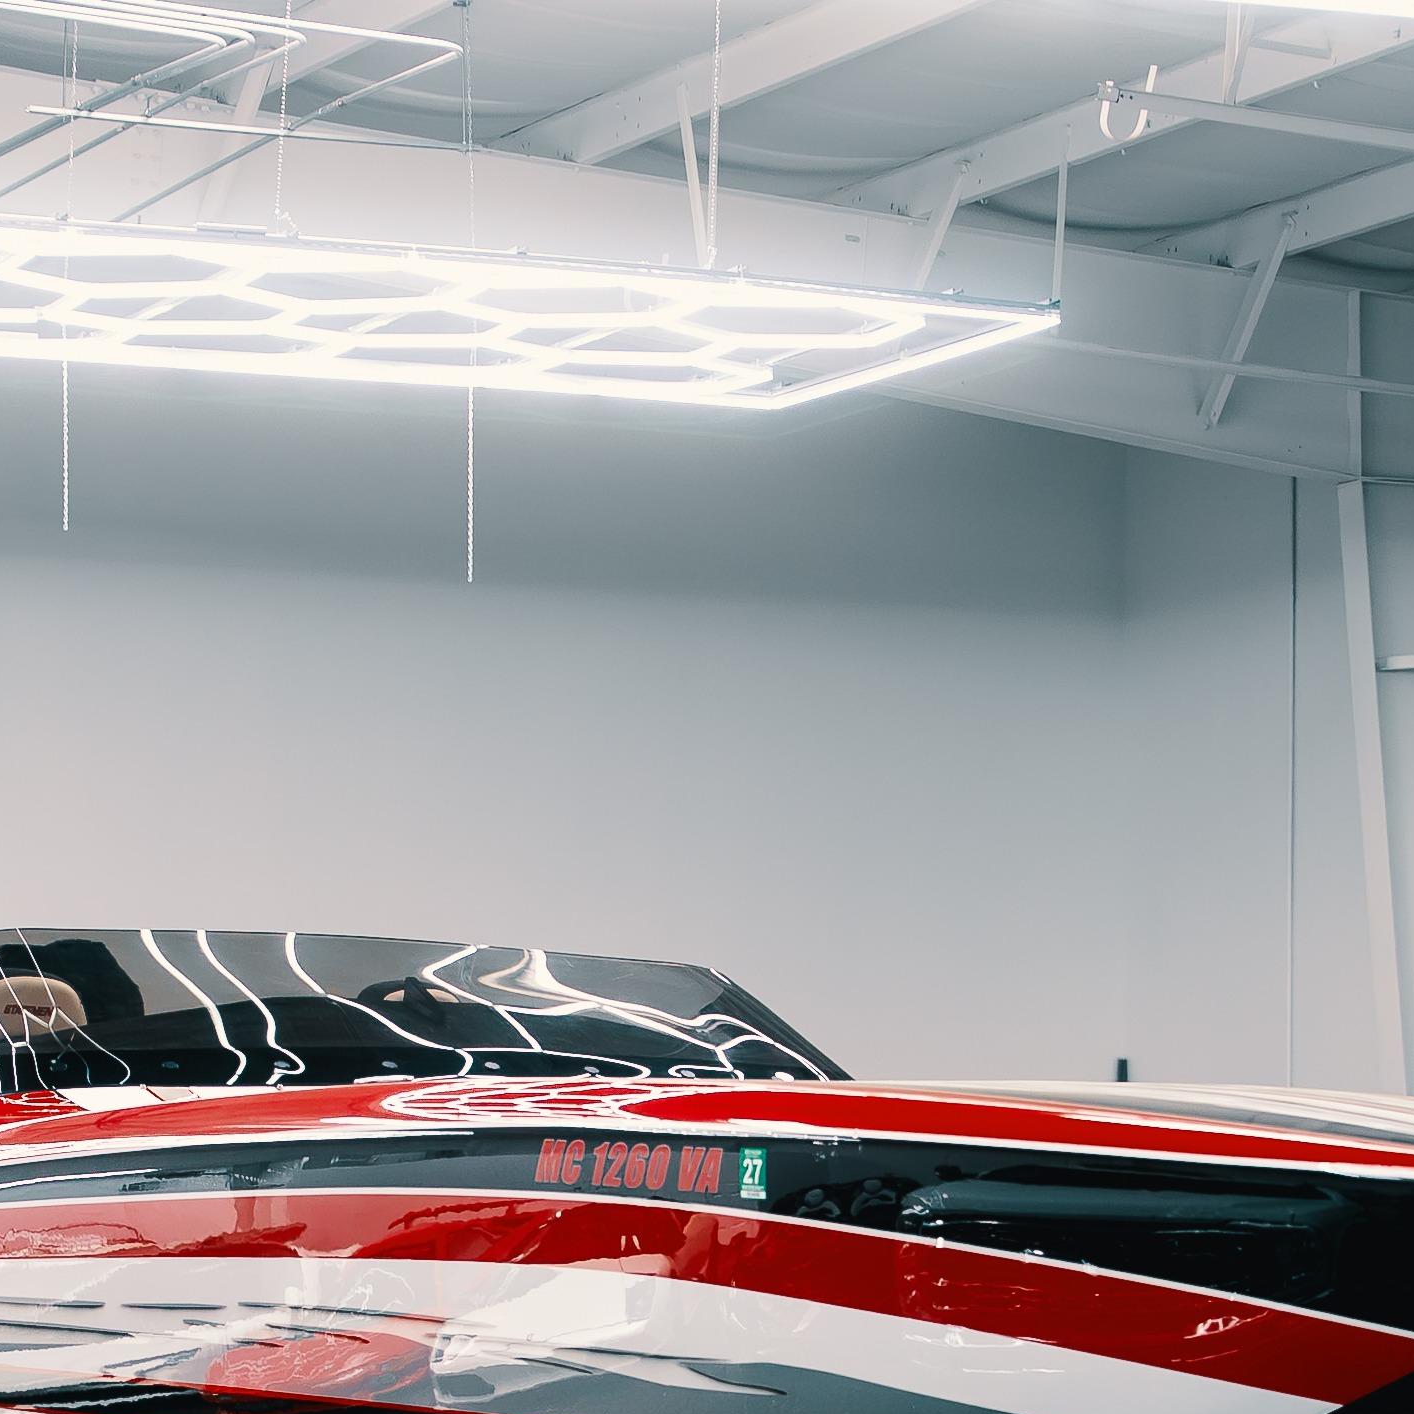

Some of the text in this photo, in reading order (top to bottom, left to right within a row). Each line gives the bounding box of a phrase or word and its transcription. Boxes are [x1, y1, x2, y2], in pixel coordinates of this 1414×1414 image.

[535, 1138, 723, 1194] MC 1260 VA
[742, 1158, 763, 1185] 27
